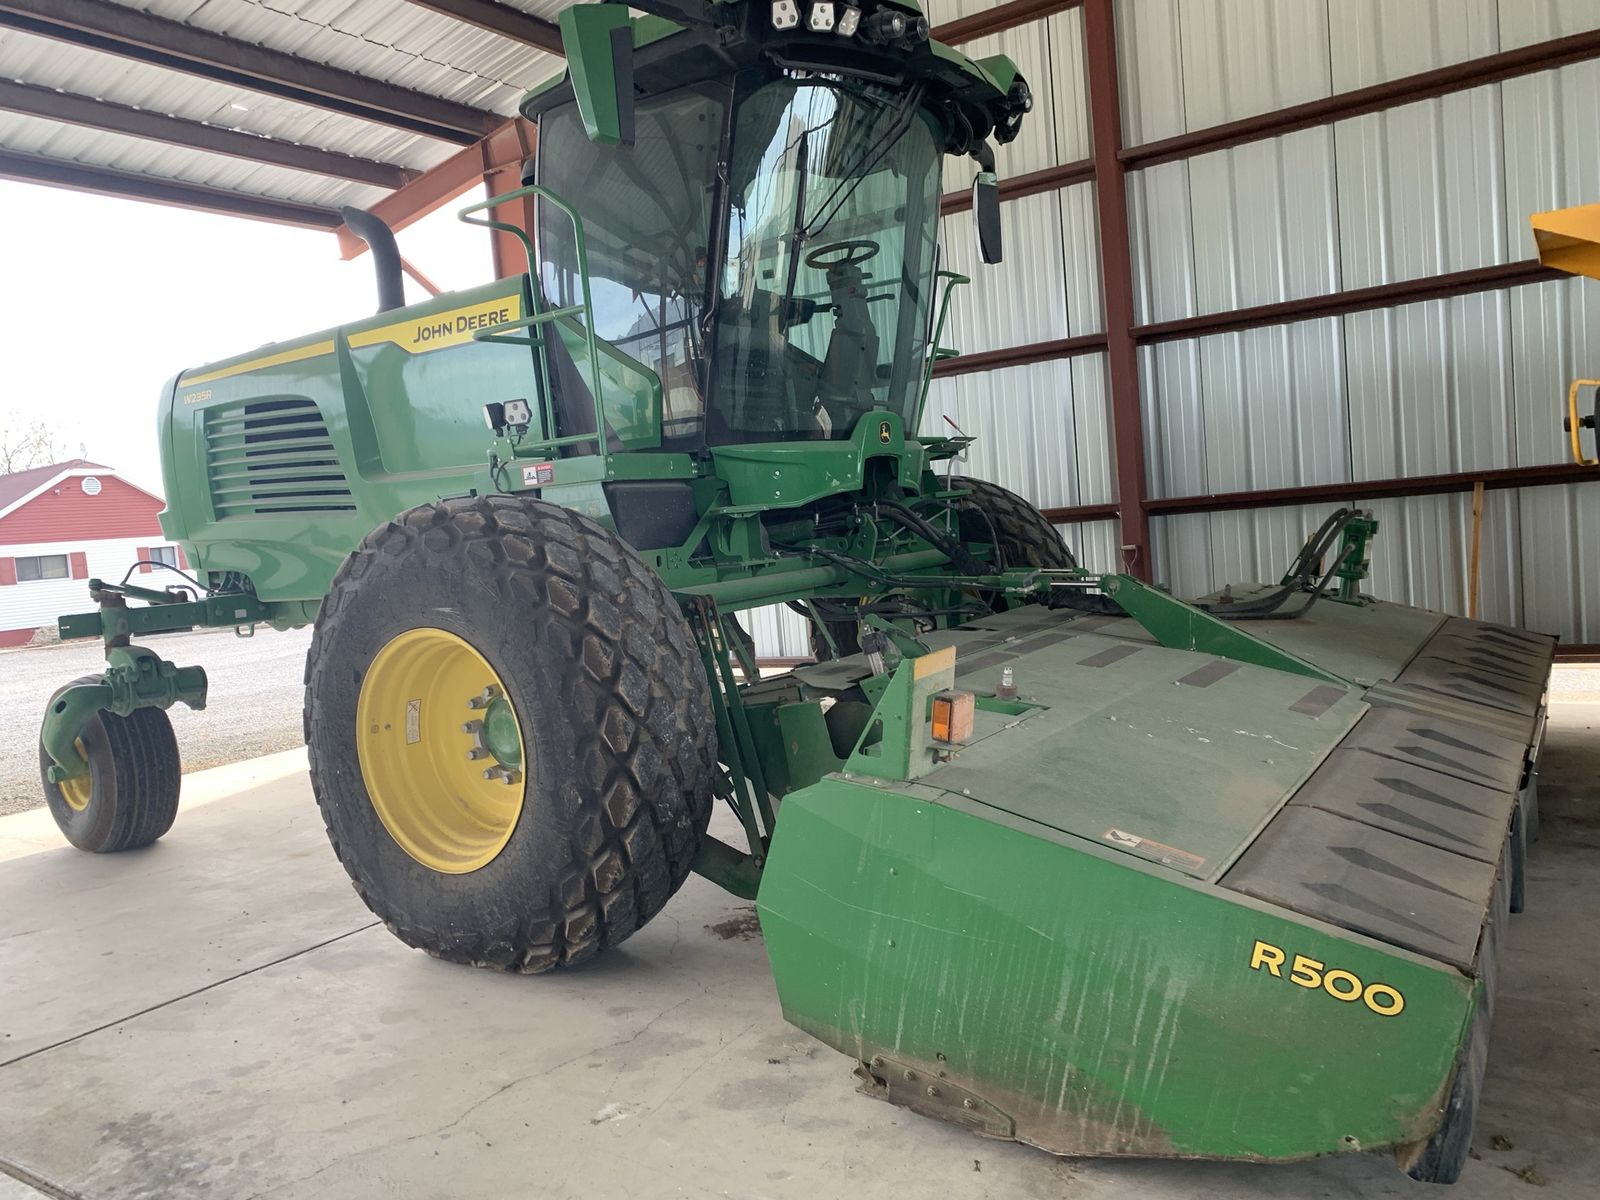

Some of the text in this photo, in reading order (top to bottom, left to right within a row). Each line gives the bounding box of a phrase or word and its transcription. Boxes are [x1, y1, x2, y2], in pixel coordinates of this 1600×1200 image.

[412, 308, 509, 344] JOHN DEERE
[183, 390, 212, 405] W235R
